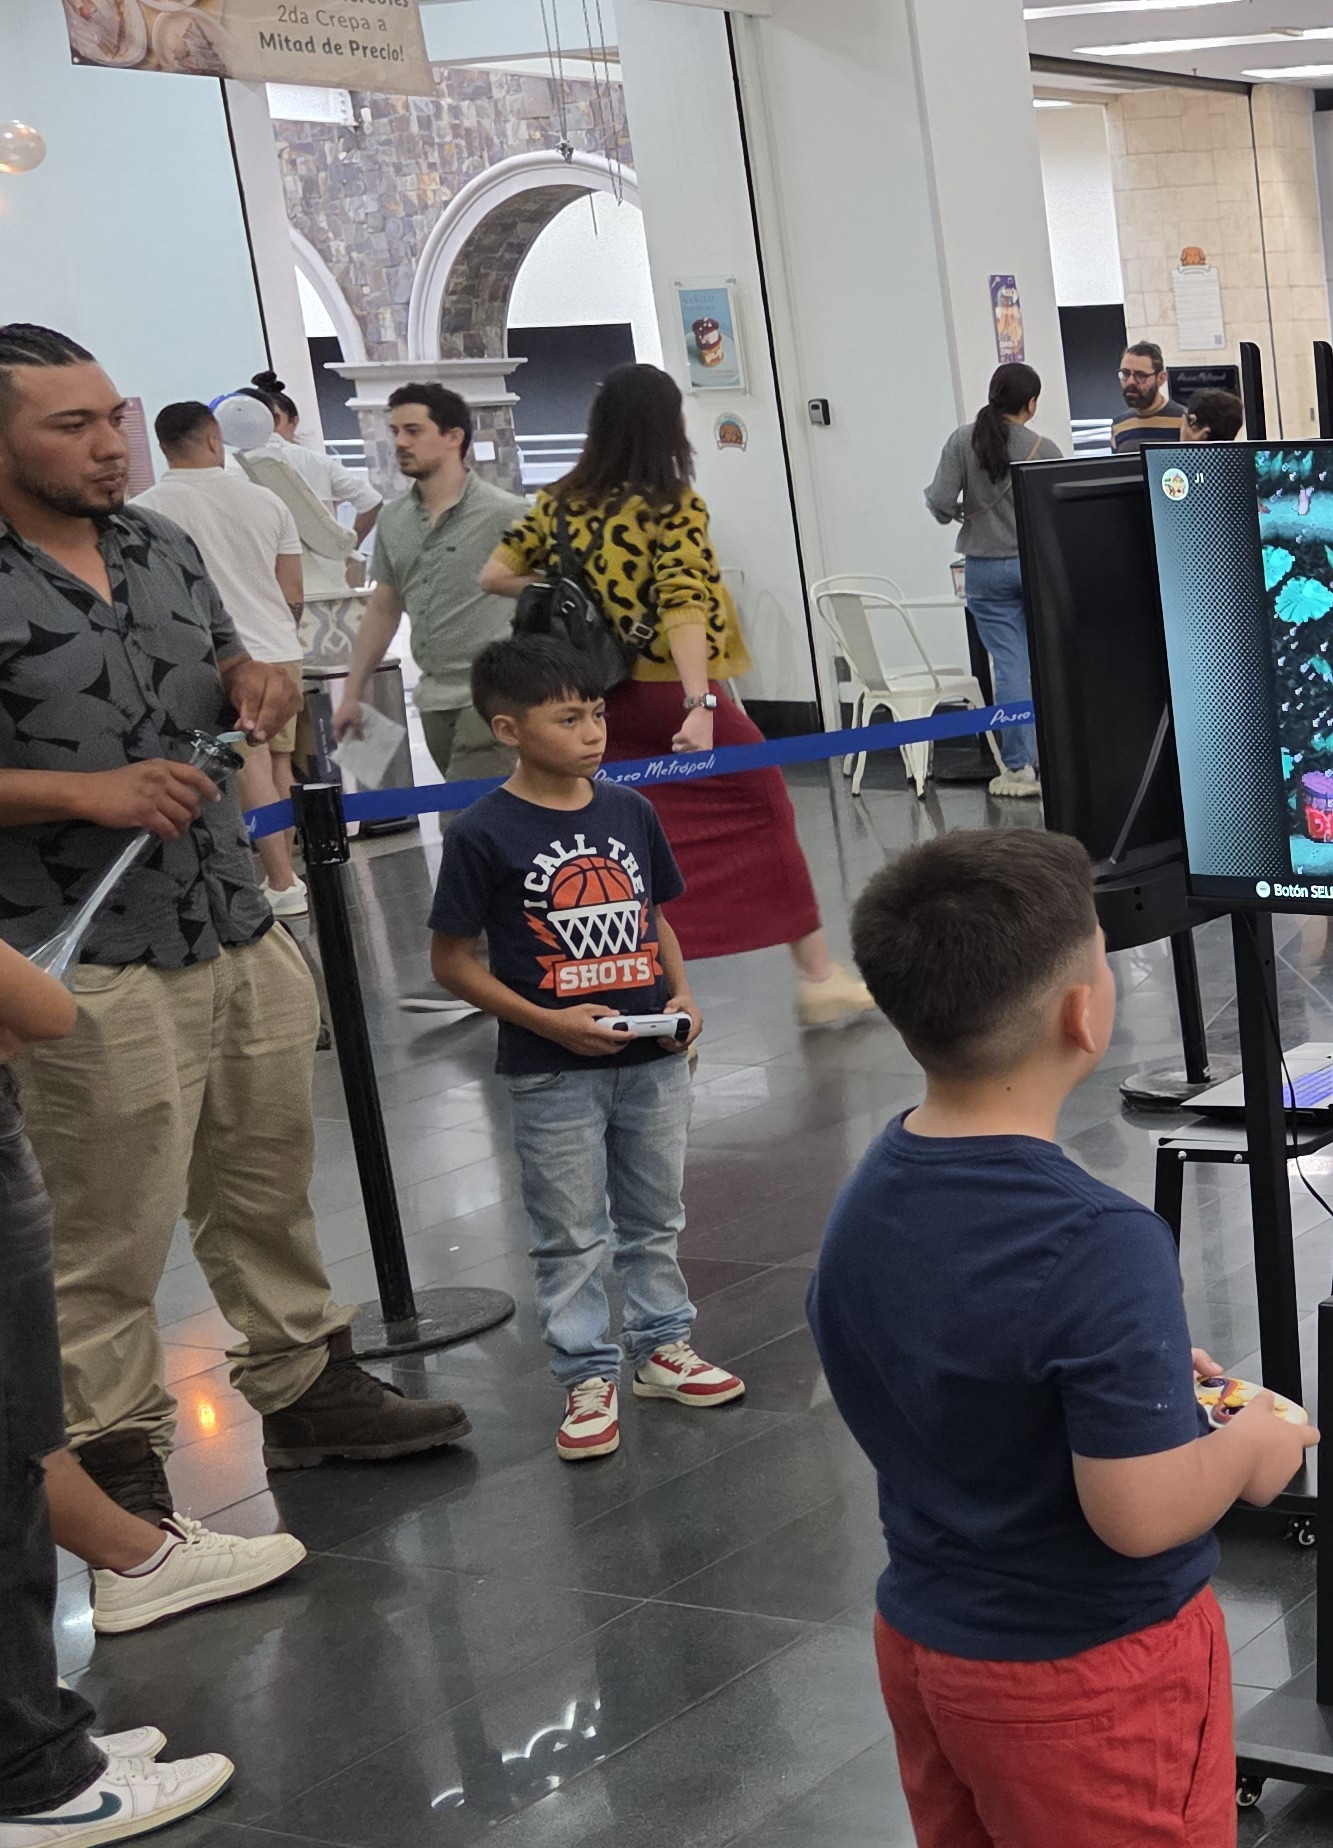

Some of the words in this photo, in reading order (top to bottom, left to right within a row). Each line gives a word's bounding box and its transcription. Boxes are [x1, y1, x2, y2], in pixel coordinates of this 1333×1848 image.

[277, 4, 309, 24] 2da
[315, 9, 371, 32] Crepa
[377, 18, 387, 31] a
[259, 32, 316, 54] Mitad
[322, 38, 344, 56] de
[349, 40, 404, 62] Precio!
[644, 753, 717, 779] Metrópoli
[524, 834, 597, 893] CALL
[607, 837, 645, 894] THE
[1274, 883, 1308, 899] Botón
[559, 956, 652, 991] SHOTS
